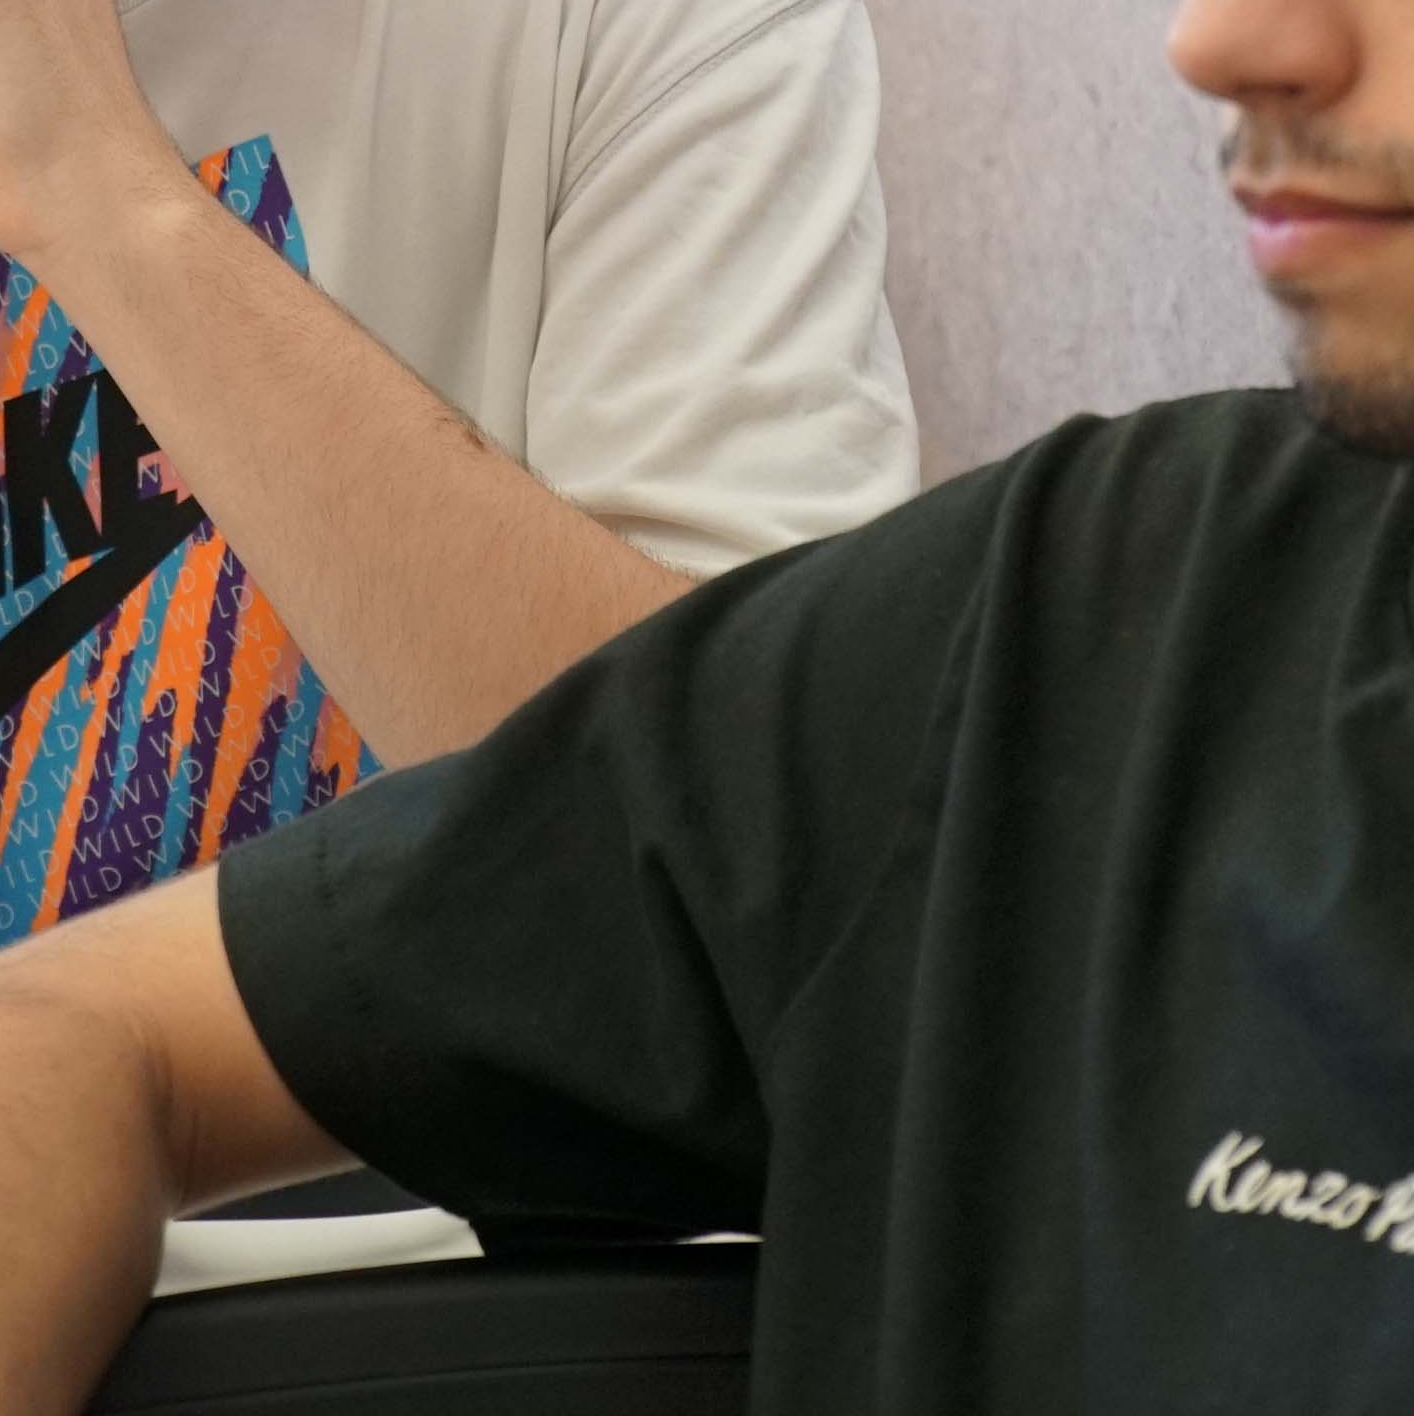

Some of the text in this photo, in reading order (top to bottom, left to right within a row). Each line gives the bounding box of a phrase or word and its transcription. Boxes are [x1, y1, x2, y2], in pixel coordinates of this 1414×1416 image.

[167, 585, 253, 632] WILD
[132, 639, 216, 686] WILD
[50, 744, 138, 792] WILD
[151, 705, 244, 757] WILD
[111, 760, 203, 810] WILD
[74, 815, 165, 864] WILD
[1187, 1130, 1381, 1230] Kenzo
